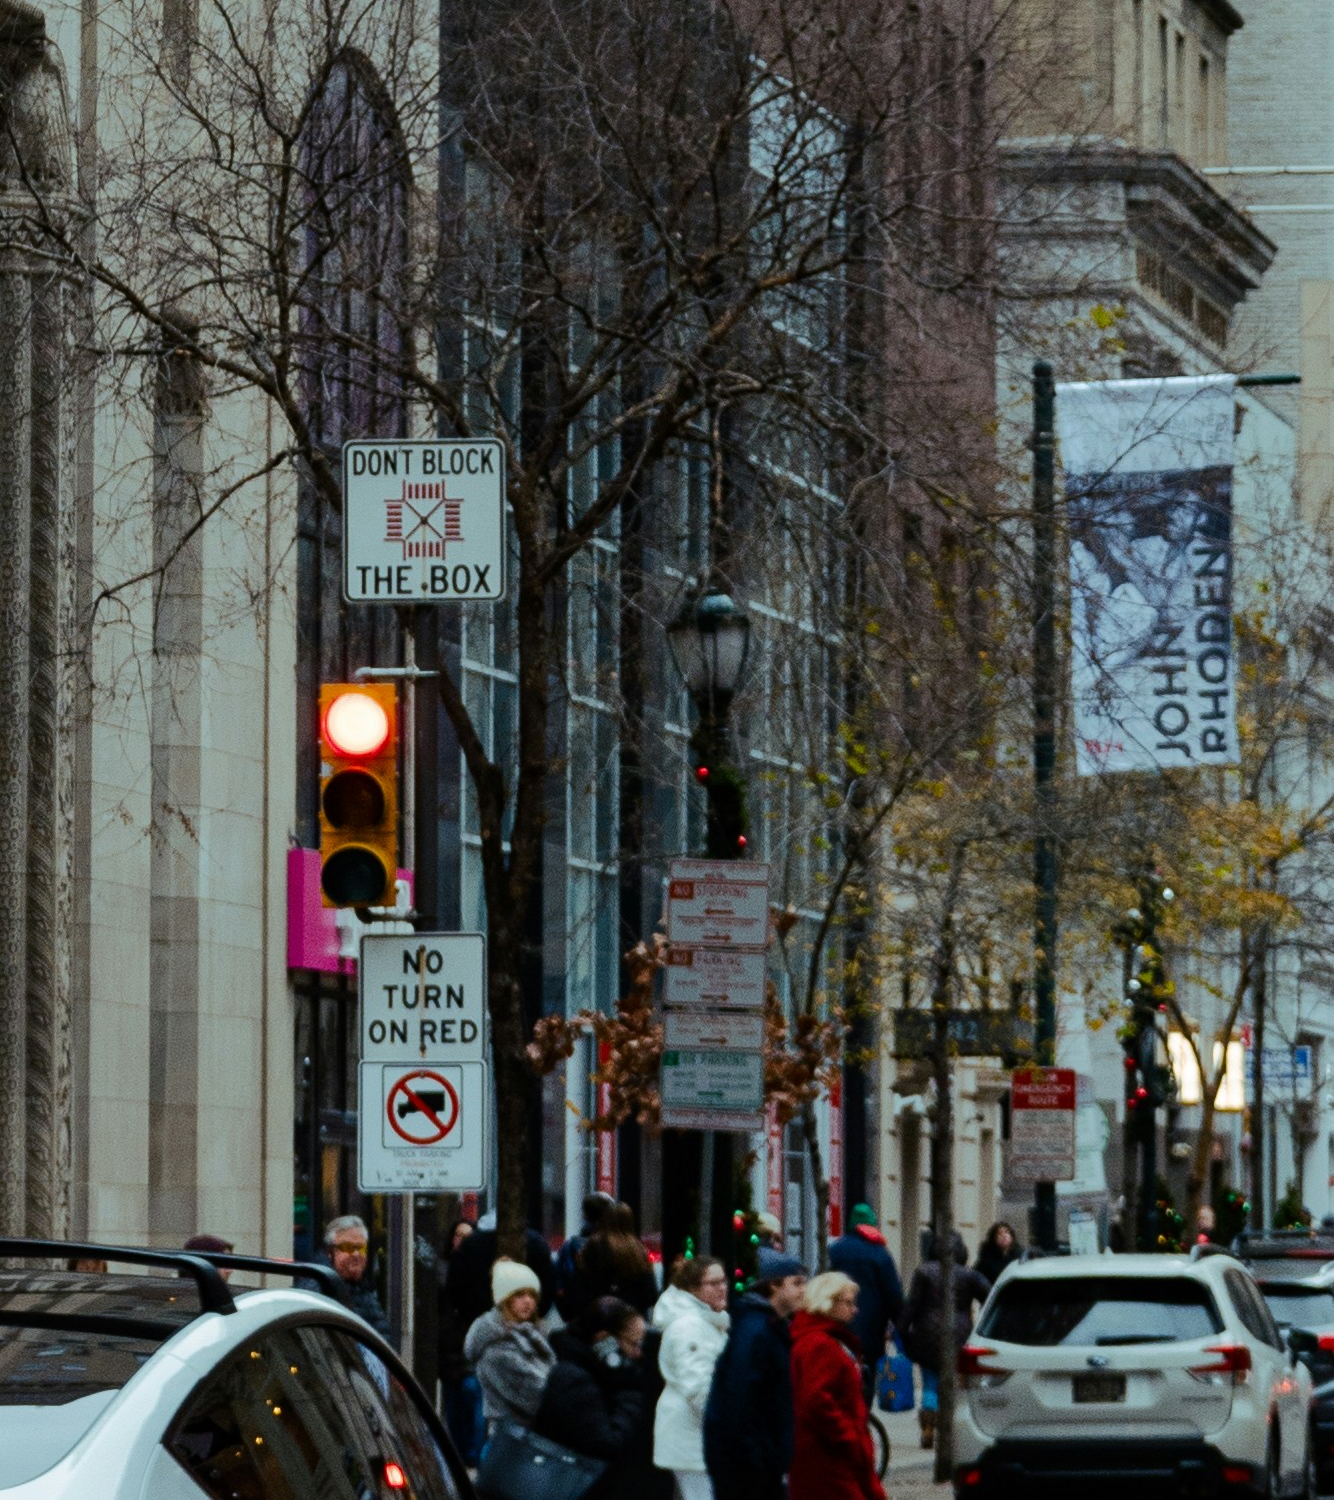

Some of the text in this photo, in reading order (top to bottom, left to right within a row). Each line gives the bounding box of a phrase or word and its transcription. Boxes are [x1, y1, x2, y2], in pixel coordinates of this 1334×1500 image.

[422, 449, 495, 475] BLOCK
[356, 565, 491, 595] THE BOX
[1154, 546, 1230, 758] JOHN RHODEN
[403, 949, 443, 975] NO
[383, 984, 464, 1009] TURN
[369, 1019, 477, 1044] ON RED
